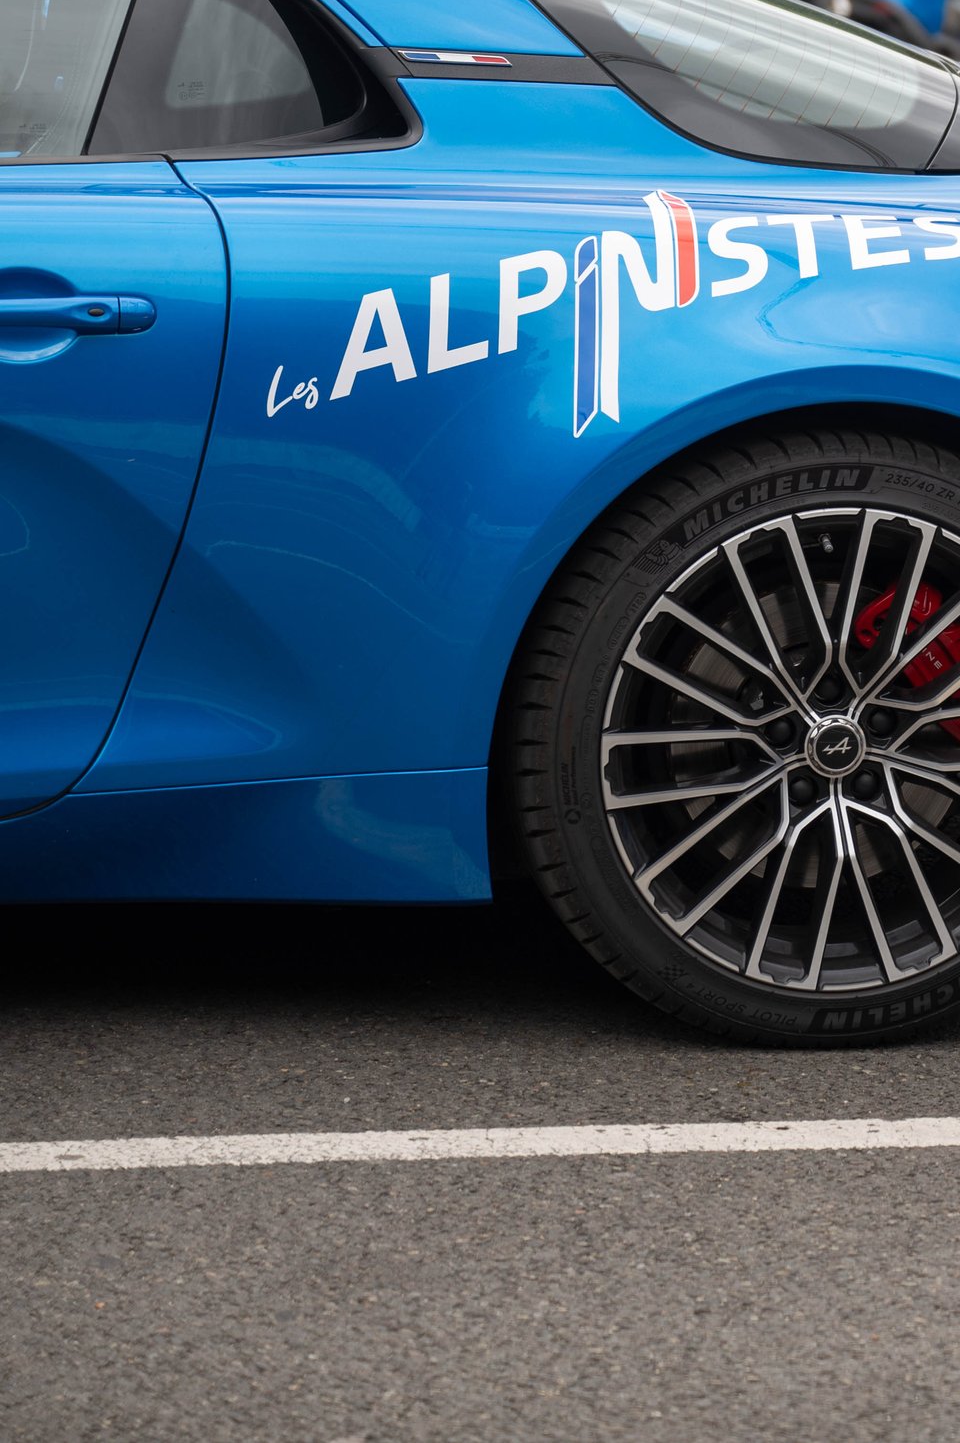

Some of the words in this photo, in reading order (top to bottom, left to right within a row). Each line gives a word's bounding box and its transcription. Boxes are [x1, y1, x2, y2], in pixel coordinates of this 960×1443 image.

[266, 364, 320, 418] Les
[885, 473, 935, 493] 235/40
[935, 486, 956, 502] ZR
[683, 468, 860, 542] MICHELIN
[701, 988, 746, 1015] SPORT
[751, 1009, 799, 1027] PILOT
